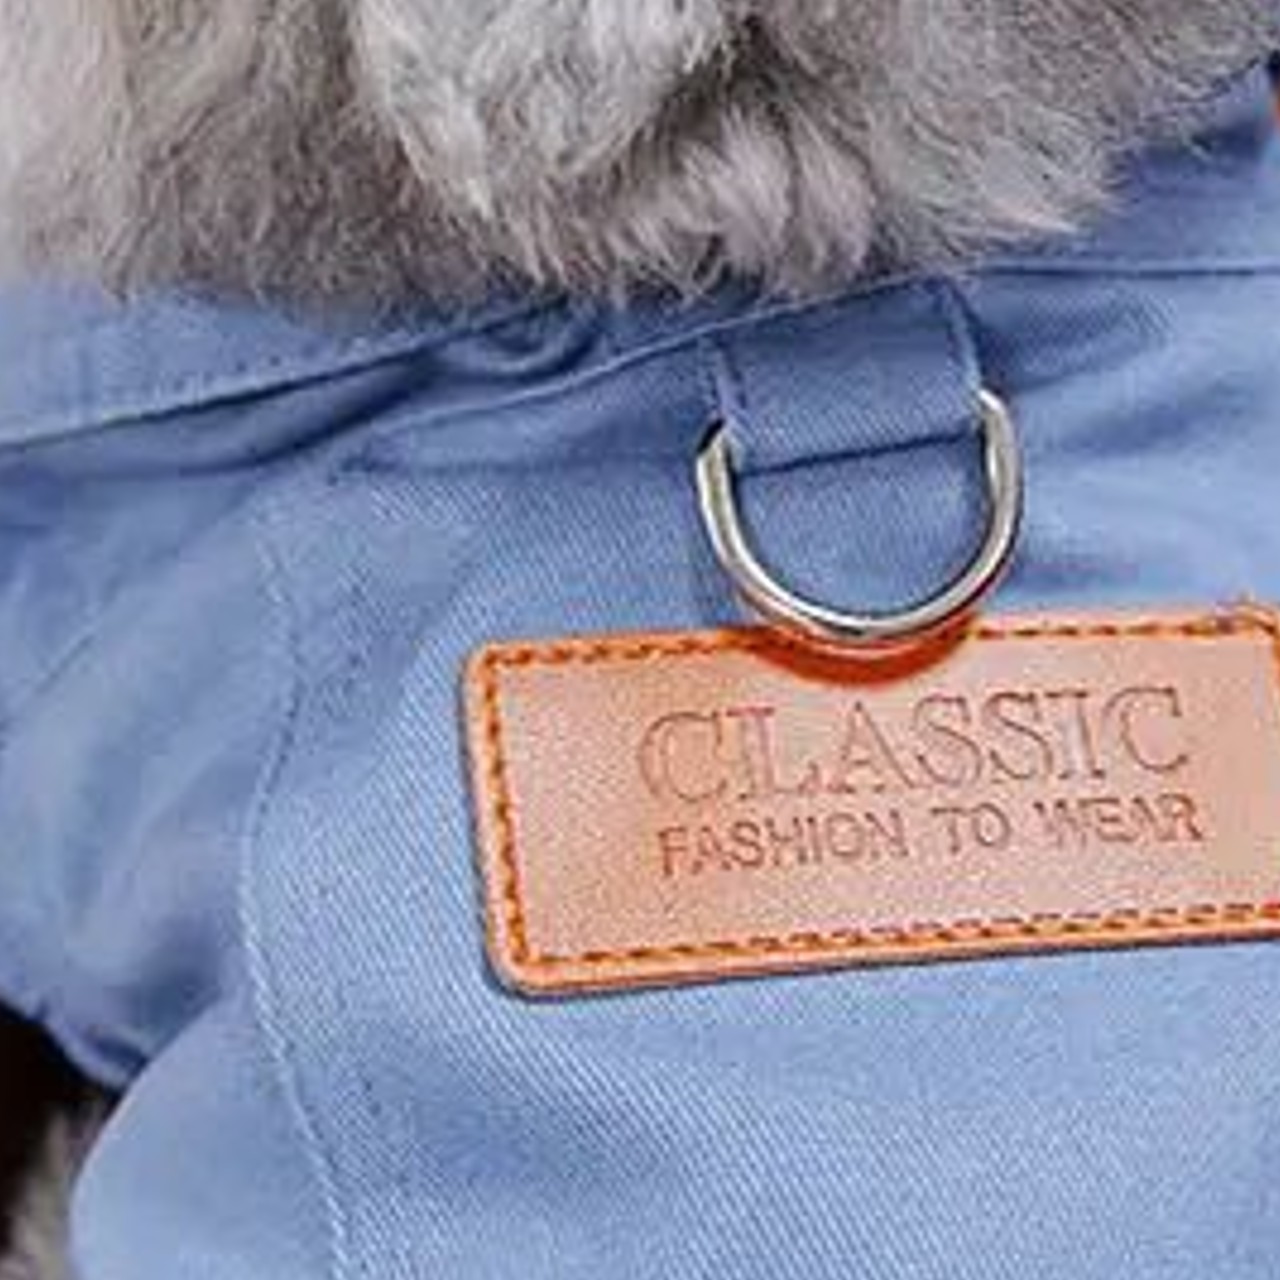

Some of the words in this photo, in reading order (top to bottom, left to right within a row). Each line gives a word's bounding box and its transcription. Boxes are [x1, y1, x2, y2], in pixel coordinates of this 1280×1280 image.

[637, 686, 1189, 806] CLASSIC
[657, 810, 909, 877] FASHION
[929, 802, 1012, 855] TO
[1031, 792, 1205, 850] WEAR
